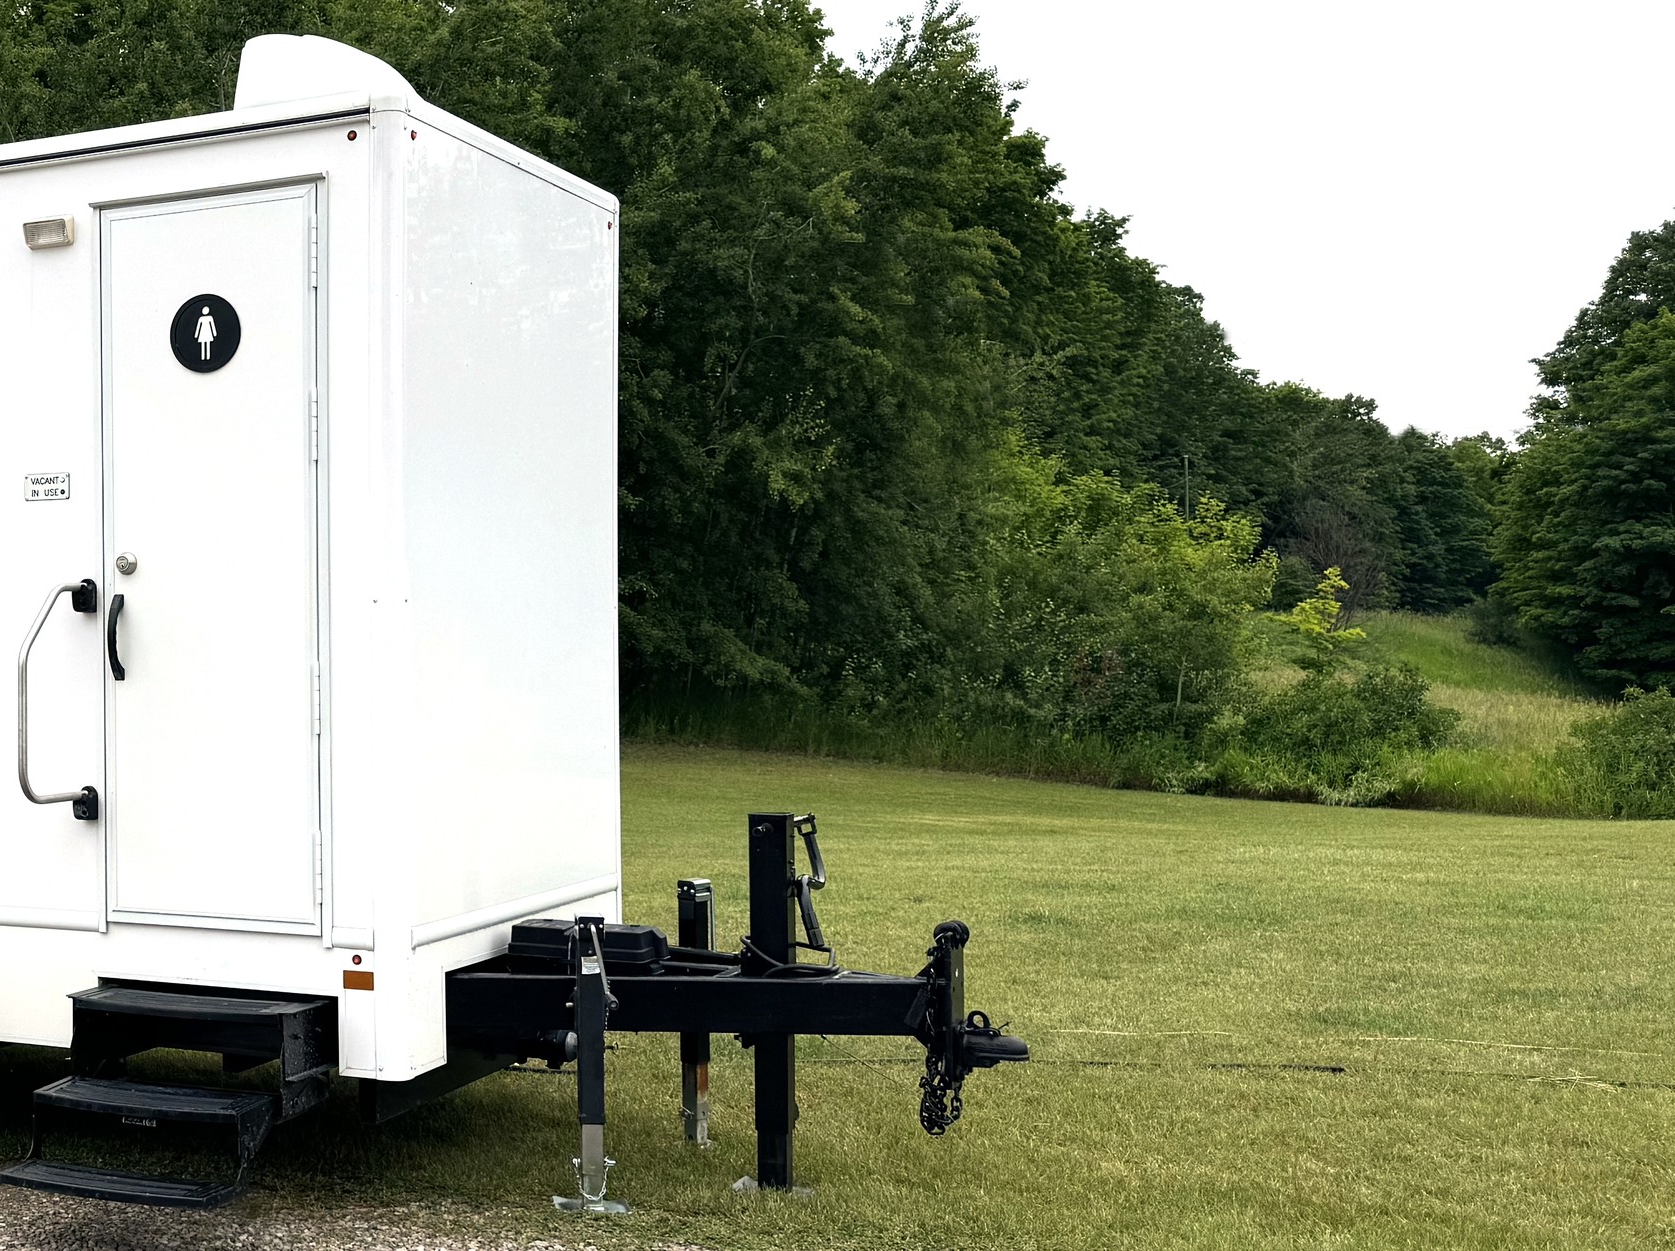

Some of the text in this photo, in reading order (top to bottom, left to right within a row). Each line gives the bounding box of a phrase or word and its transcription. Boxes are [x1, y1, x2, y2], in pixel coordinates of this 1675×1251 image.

[30, 476, 59, 485] VACANT
[31, 488, 59, 497] IN USE
